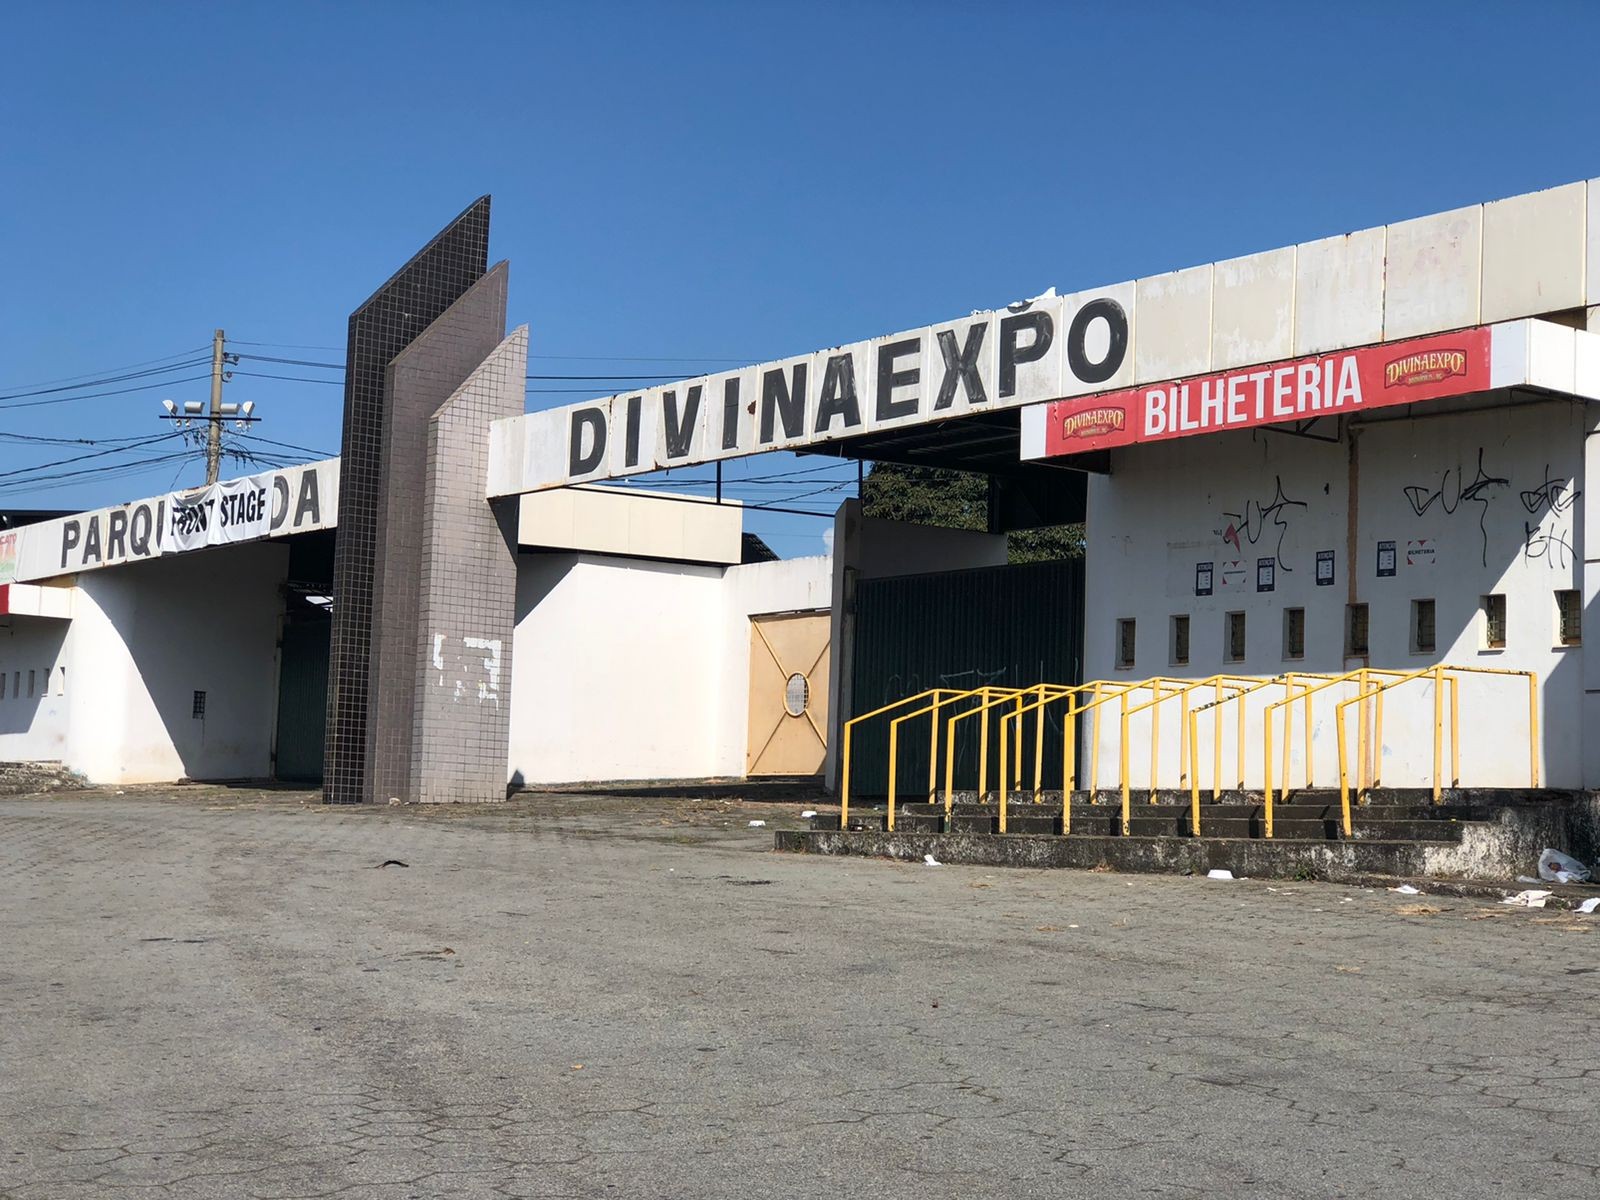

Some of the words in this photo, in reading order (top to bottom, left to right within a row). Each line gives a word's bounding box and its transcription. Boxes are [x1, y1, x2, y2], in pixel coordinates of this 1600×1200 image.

[569, 298, 1129, 477] DIVINAEXPO
[1386, 352, 1465, 384] DIVINAEXPO
[1144, 355, 1363, 437] BILHETERIA
[1064, 410, 1124, 436] DIVINAEXPO
[220, 487, 266, 528] STAGE
